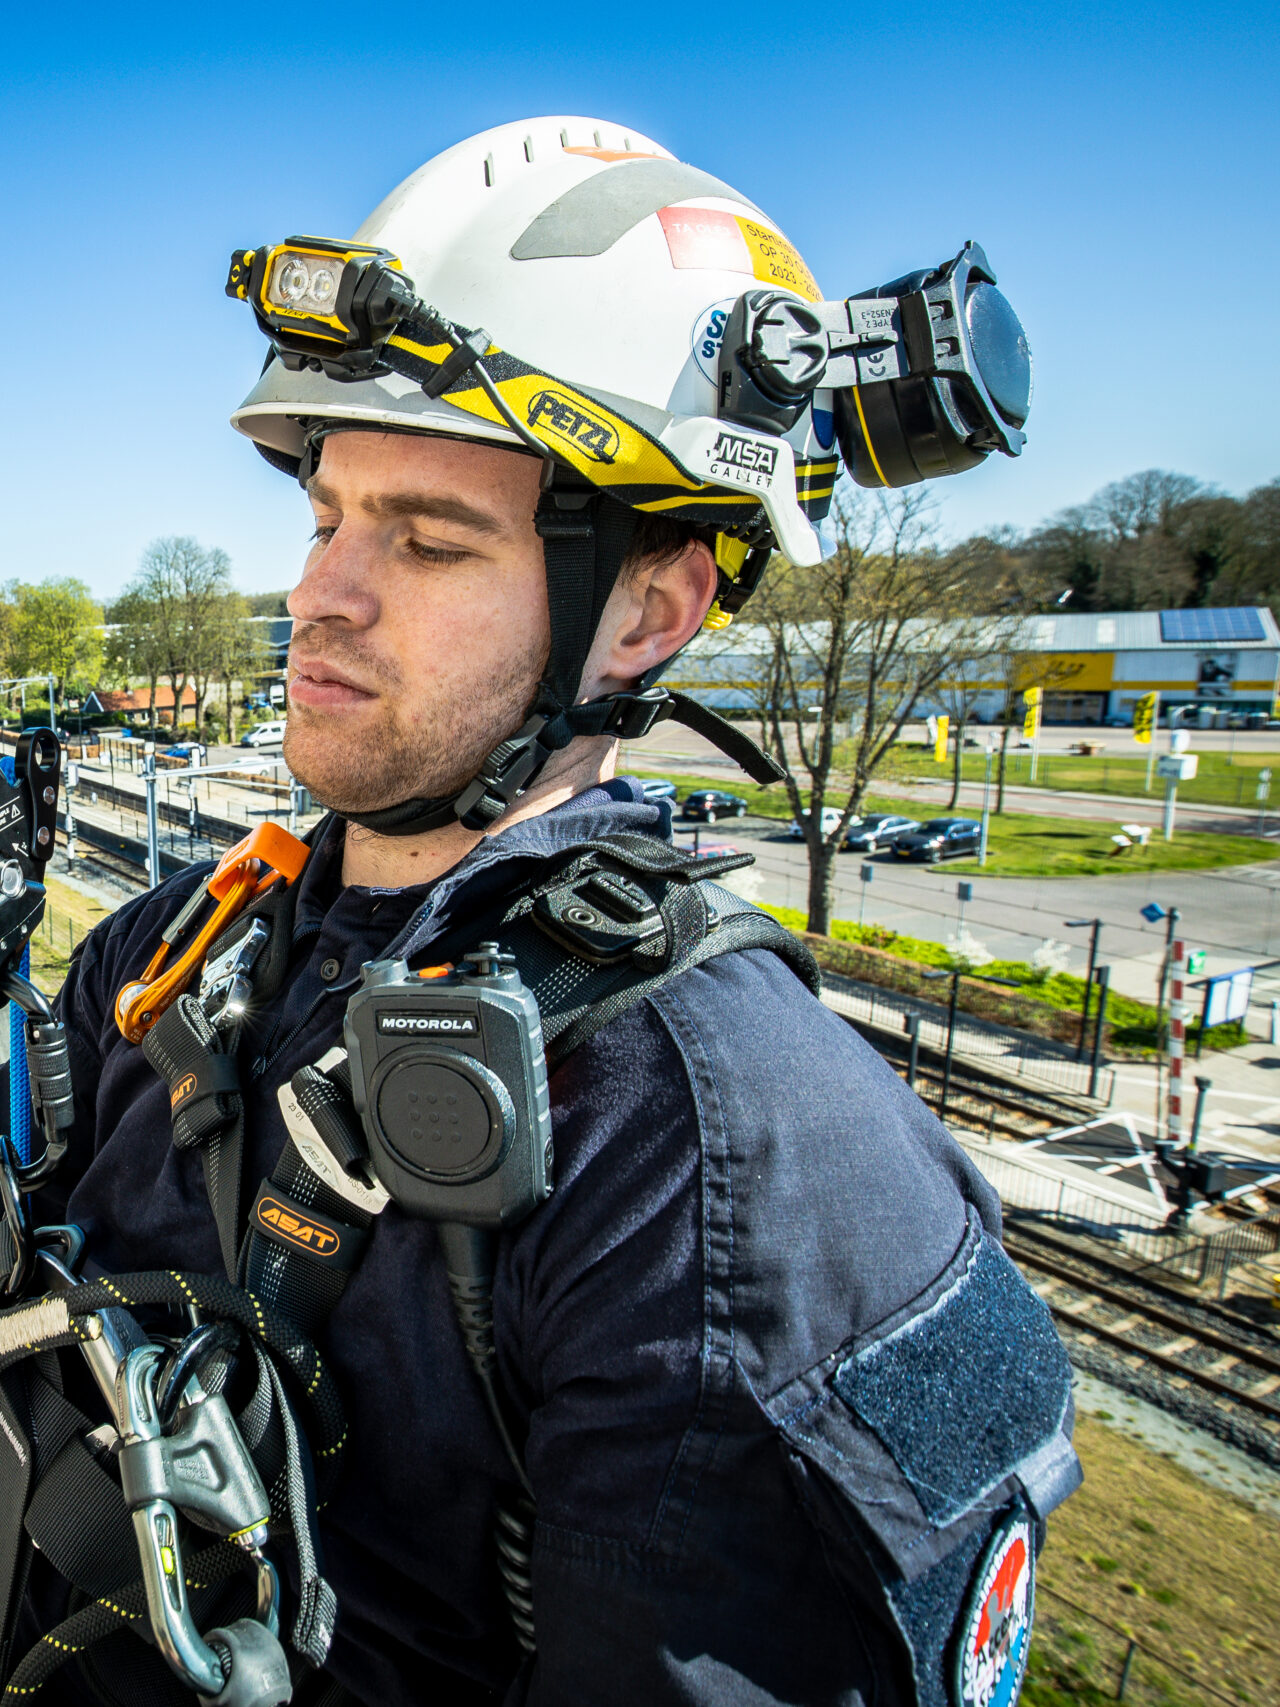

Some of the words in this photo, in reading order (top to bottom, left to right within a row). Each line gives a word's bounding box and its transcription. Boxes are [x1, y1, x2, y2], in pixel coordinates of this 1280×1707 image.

[769, 263, 797, 285] 2023
[526, 395, 616, 464] PETZL
[717, 436, 775, 474] MSA
[710, 463, 773, 489] GALLET
[381, 1017, 474, 1031] MOTOROLA
[261, 1207, 336, 1250] ASAT
